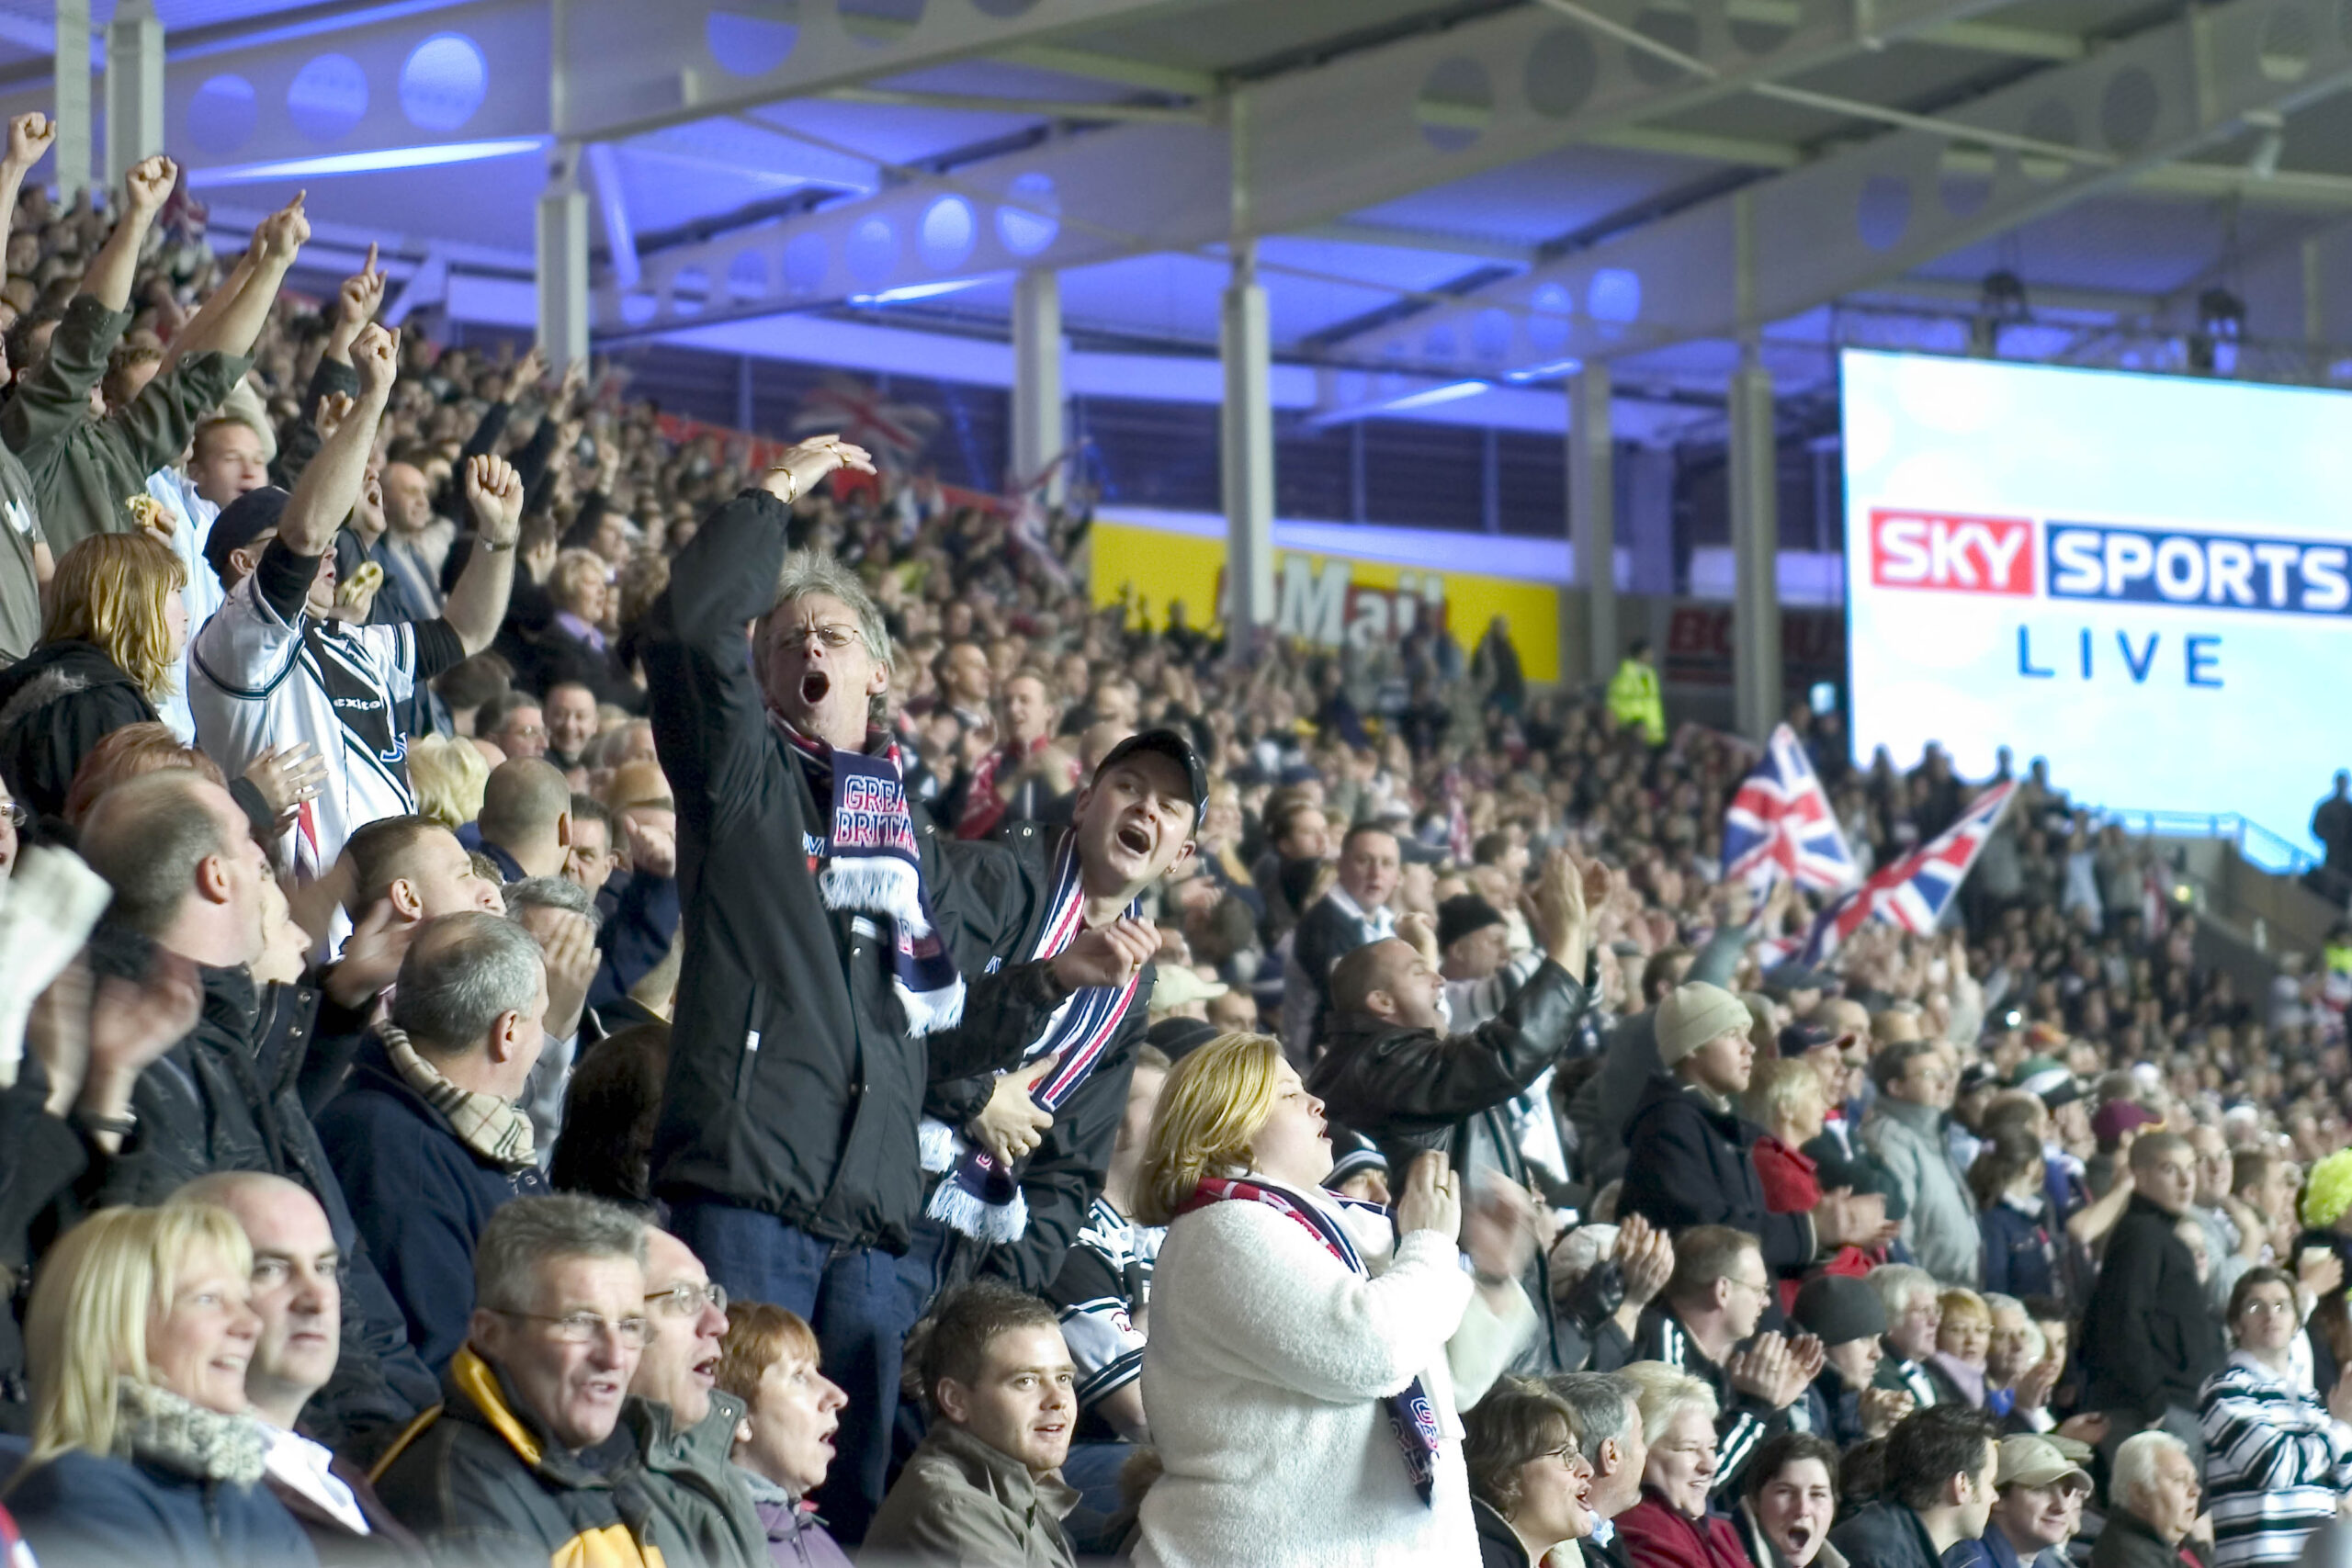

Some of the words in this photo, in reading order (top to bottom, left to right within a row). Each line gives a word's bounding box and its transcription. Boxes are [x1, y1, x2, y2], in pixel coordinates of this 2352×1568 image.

[1878, 518, 2030, 589] SKY
[2052, 528, 2350, 610] SPORTS
[2017, 624, 2224, 689] LIVE
